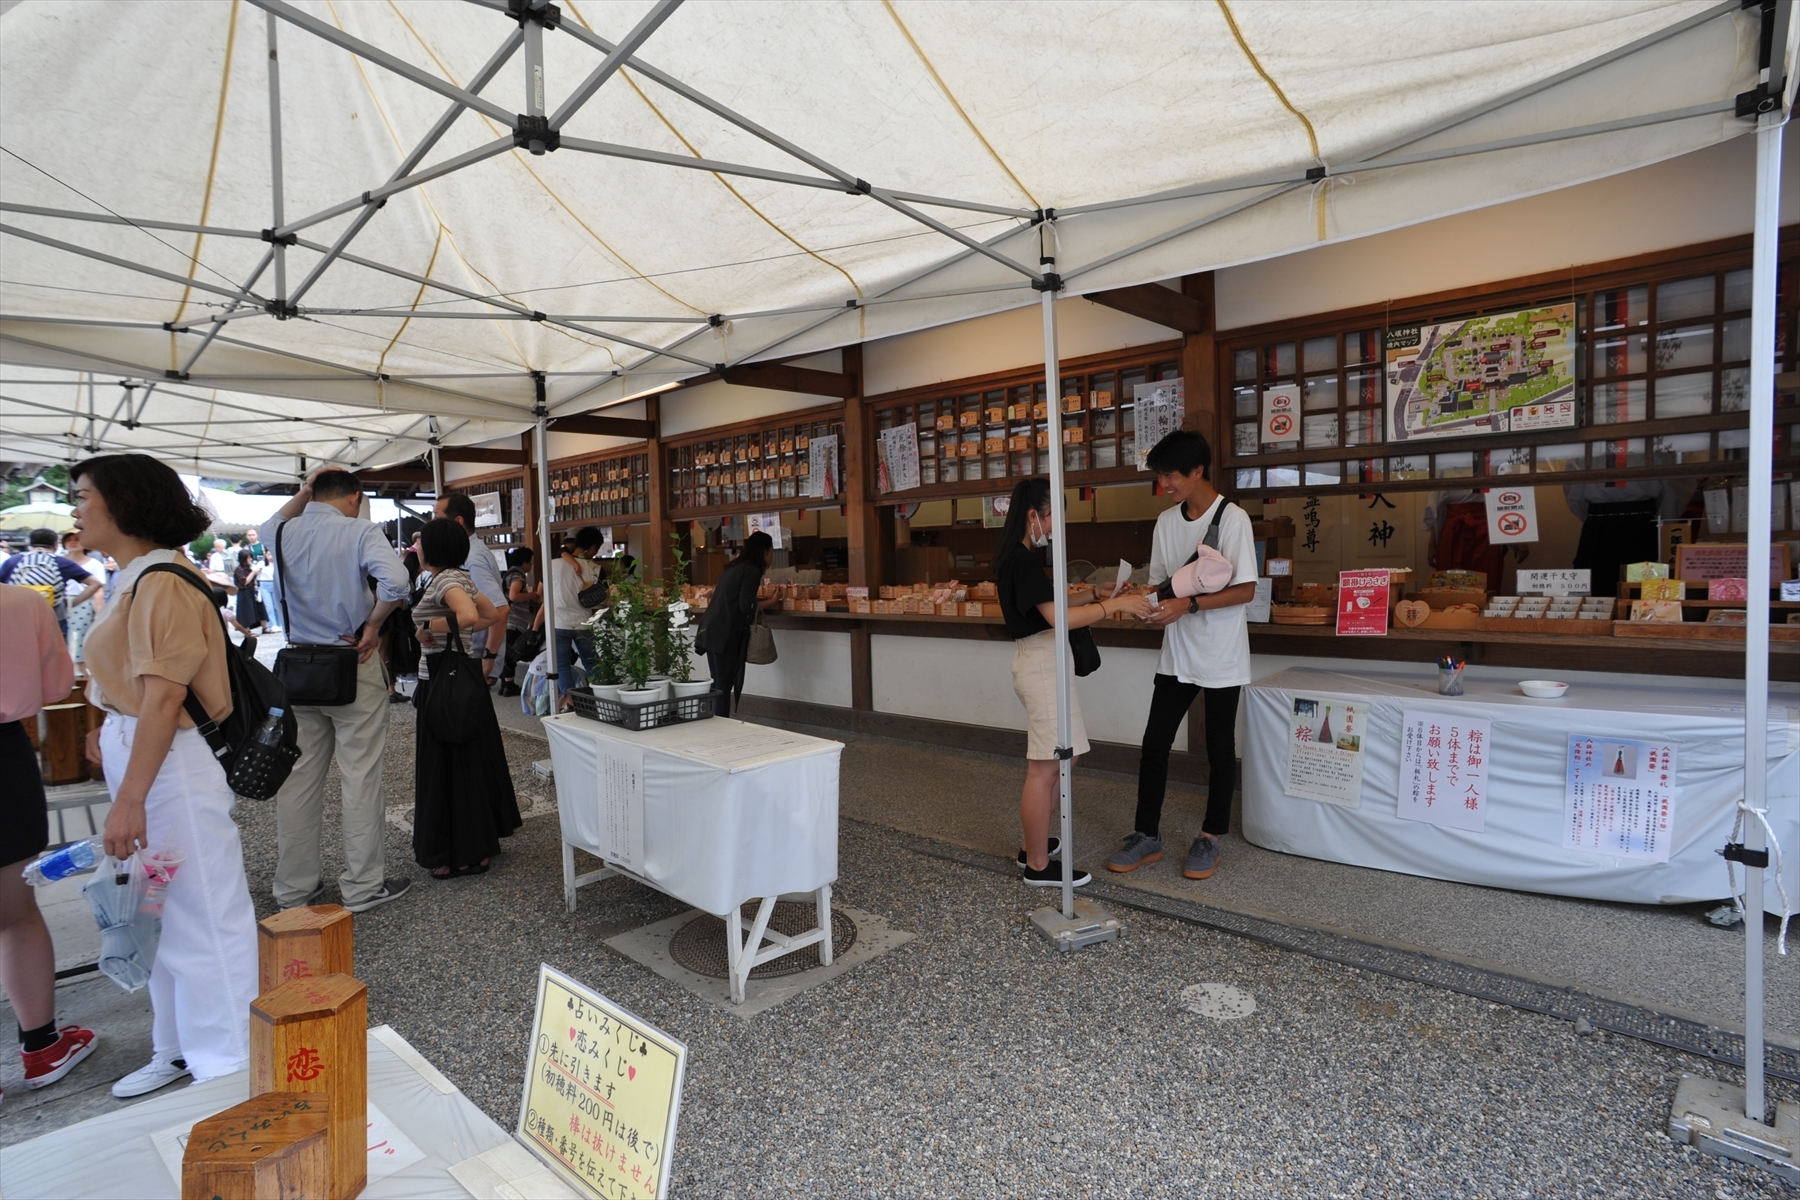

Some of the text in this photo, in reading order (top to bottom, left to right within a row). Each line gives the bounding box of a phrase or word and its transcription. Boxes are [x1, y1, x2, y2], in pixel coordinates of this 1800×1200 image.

[1386, 327, 1419, 339] 八坂神社
[1386, 338, 1419, 349] 境内マップ
[1341, 576, 1388, 588] 願掛けうさぎ
[1530, 572, 1578, 580] 開運干支守
[1295, 725, 1313, 743] 粽
[1345, 705, 1355, 733] 祇園祭
[1405, 726, 1414, 762] お受け下さい
[1446, 726, 1462, 787] 5体までで
[1424, 724, 1441, 808] お願い致します
[1463, 729, 1483, 810] 粽は御一人様
[574, 997, 639, 1053] 占いみくじ
[287, 1047, 325, 1083] 恋
[574, 1028, 628, 1078] 恋みくじ
[568, 1113, 656, 1195] 棒は抜けません
